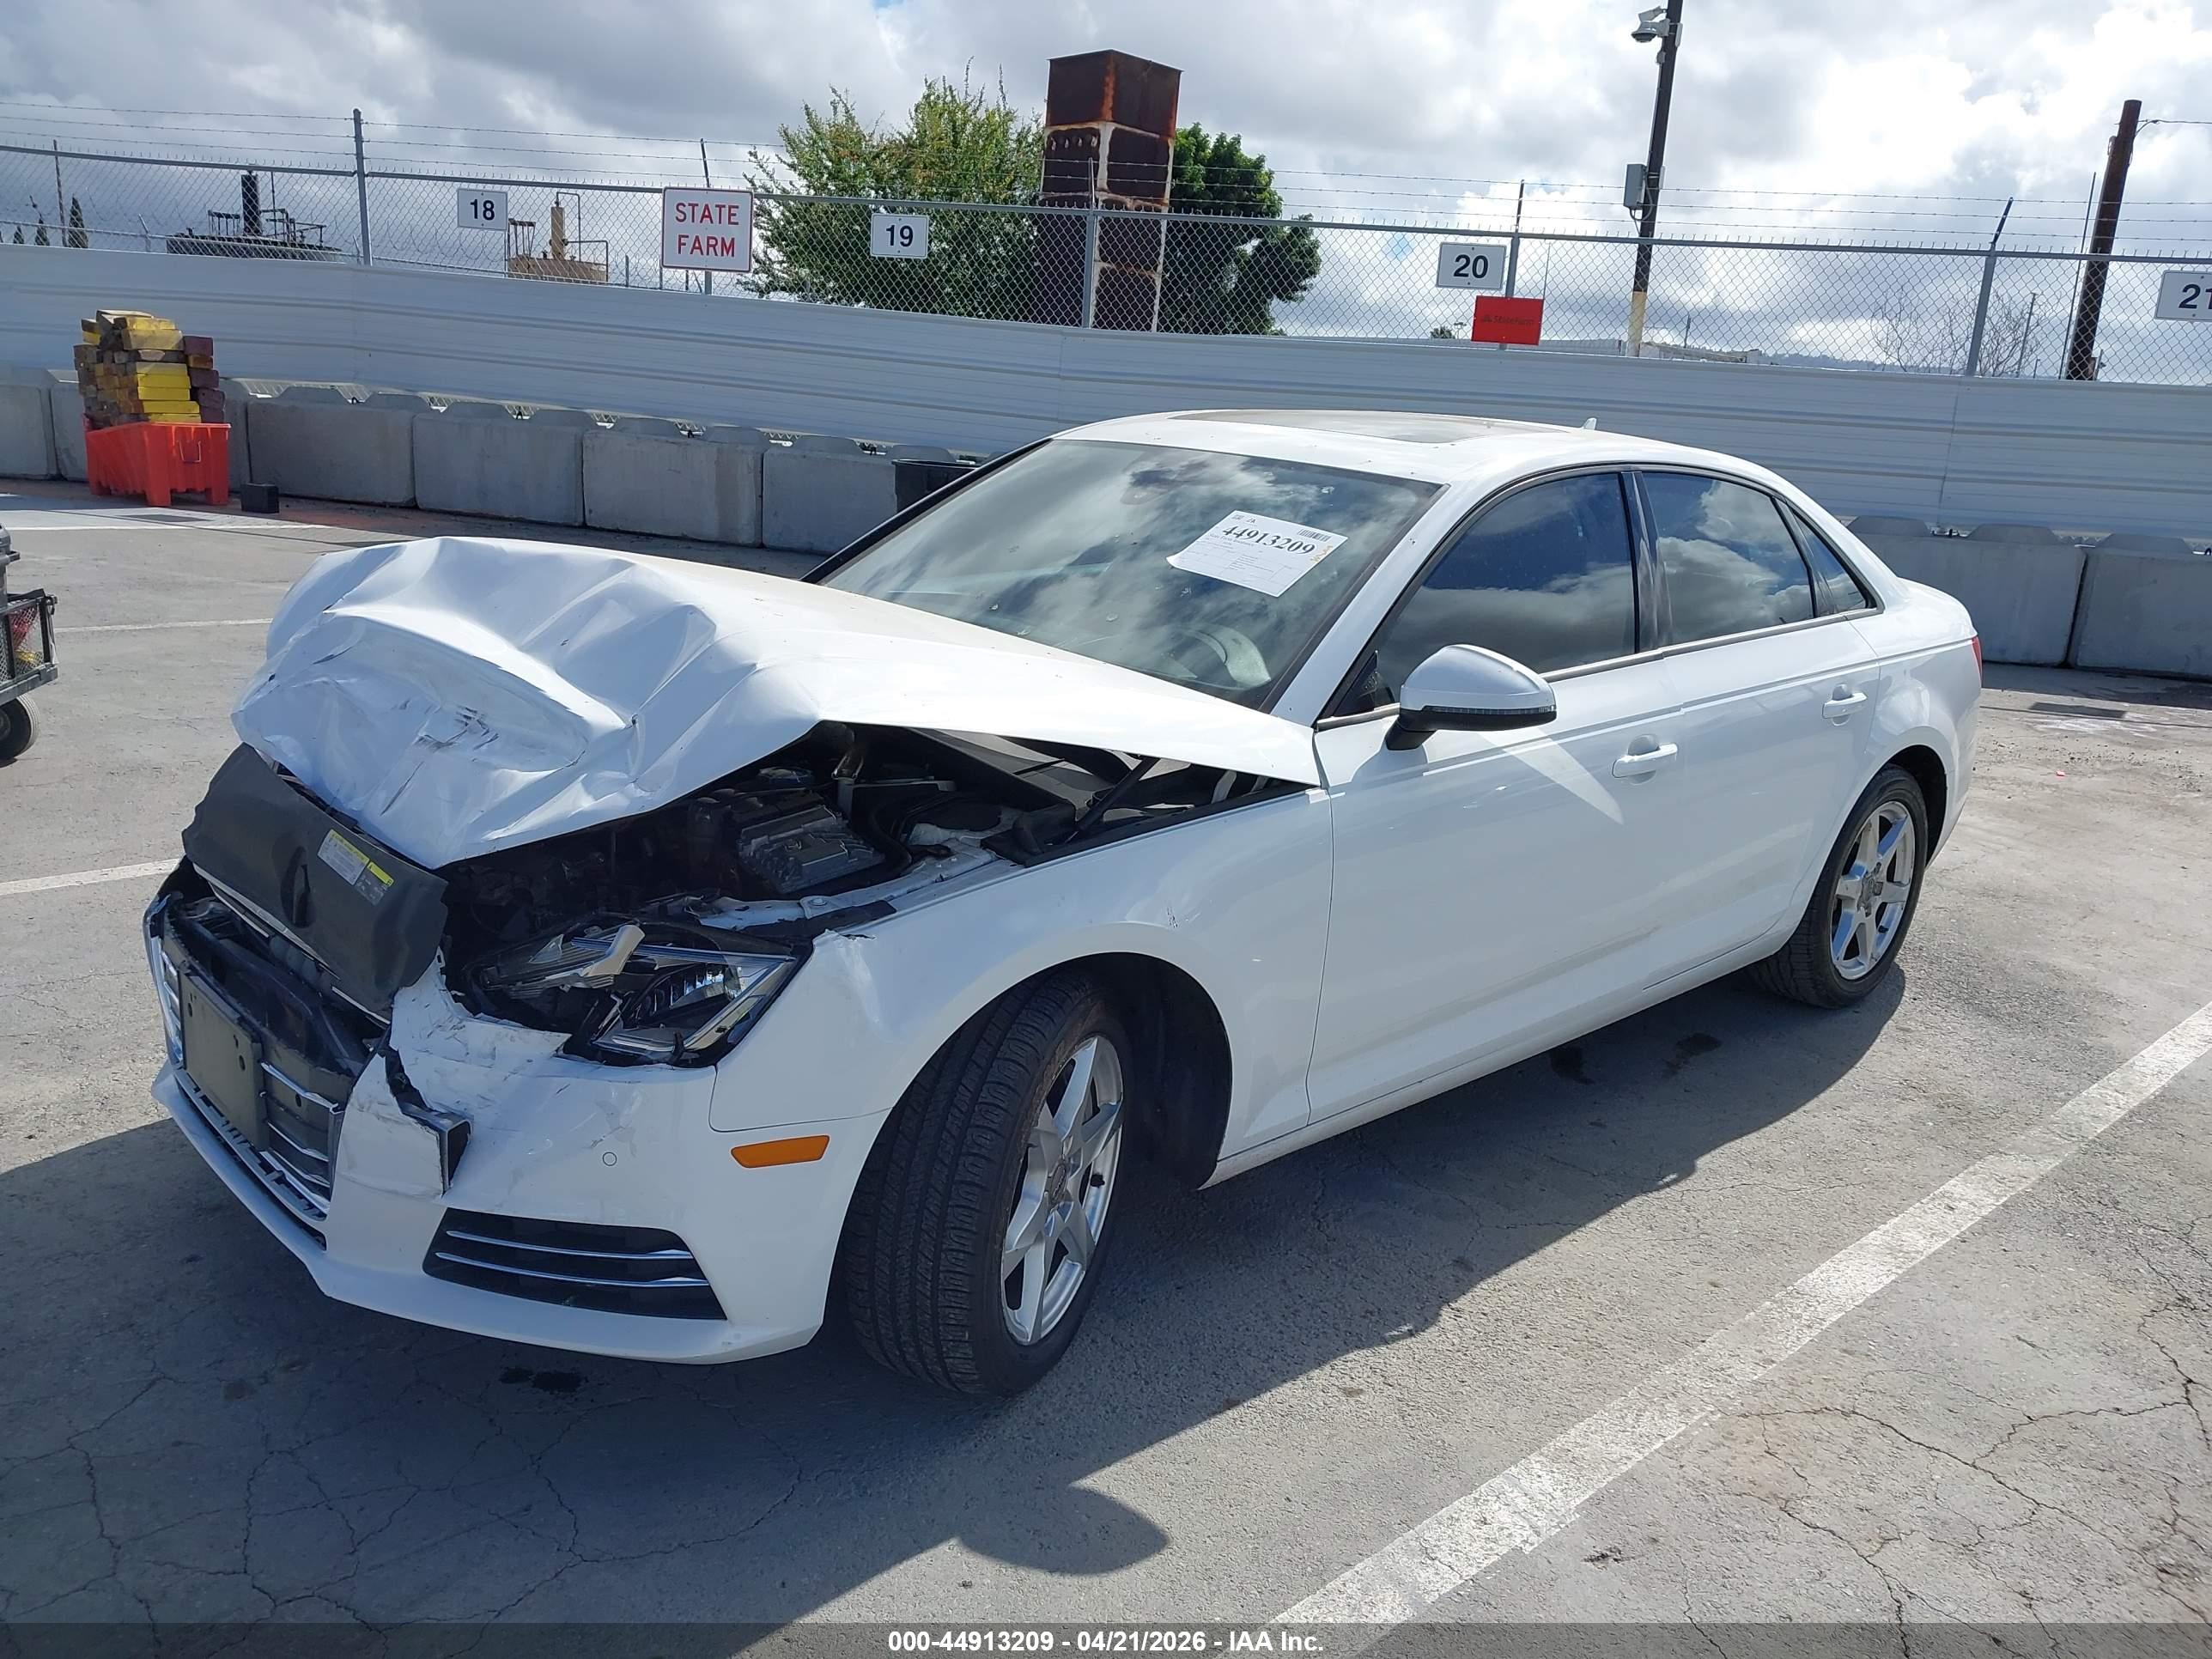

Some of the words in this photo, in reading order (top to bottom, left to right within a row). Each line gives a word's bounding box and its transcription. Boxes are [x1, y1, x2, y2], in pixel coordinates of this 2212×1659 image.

[470, 198, 495, 221] 18
[675, 202, 739, 225] STATE
[677, 234, 735, 258] FARM
[885, 224, 914, 247] 19
[1453, 254, 1489, 279] 20
[1222, 526, 1316, 555] 44913209
